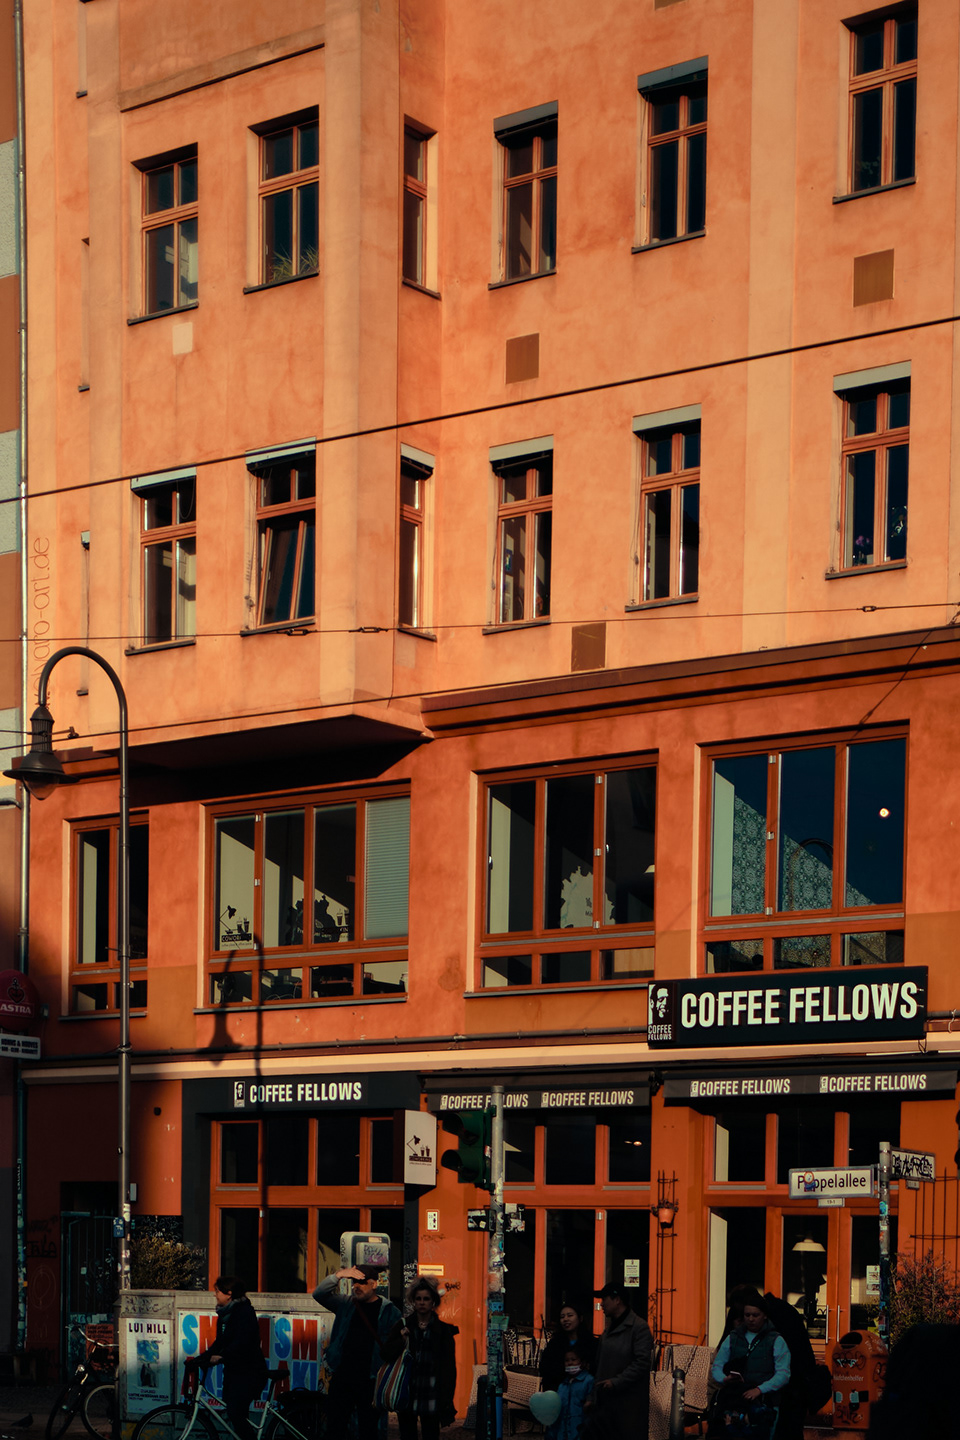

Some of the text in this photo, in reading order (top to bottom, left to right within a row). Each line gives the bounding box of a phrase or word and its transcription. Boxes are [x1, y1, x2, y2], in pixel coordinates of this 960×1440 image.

[0, 1003, 31, 1014] ASTRA
[681, 982, 918, 1028] COFFEE FELLOWS
[648, 1024, 671, 1034] COFFEE
[700, 1078, 790, 1096] COFFEE FELLOWS
[828, 1074, 927, 1093] COFFEE FELLOWS
[250, 1082, 362, 1103] COFFEE FELLOWS
[549, 1090, 634, 1106] COFFEE FELLOWS
[448, 1094, 528, 1109] COFFEE FLOWS
[798, 1174, 866, 1191] Pppelallee
[129, 1323, 167, 1334] LUI HILL
